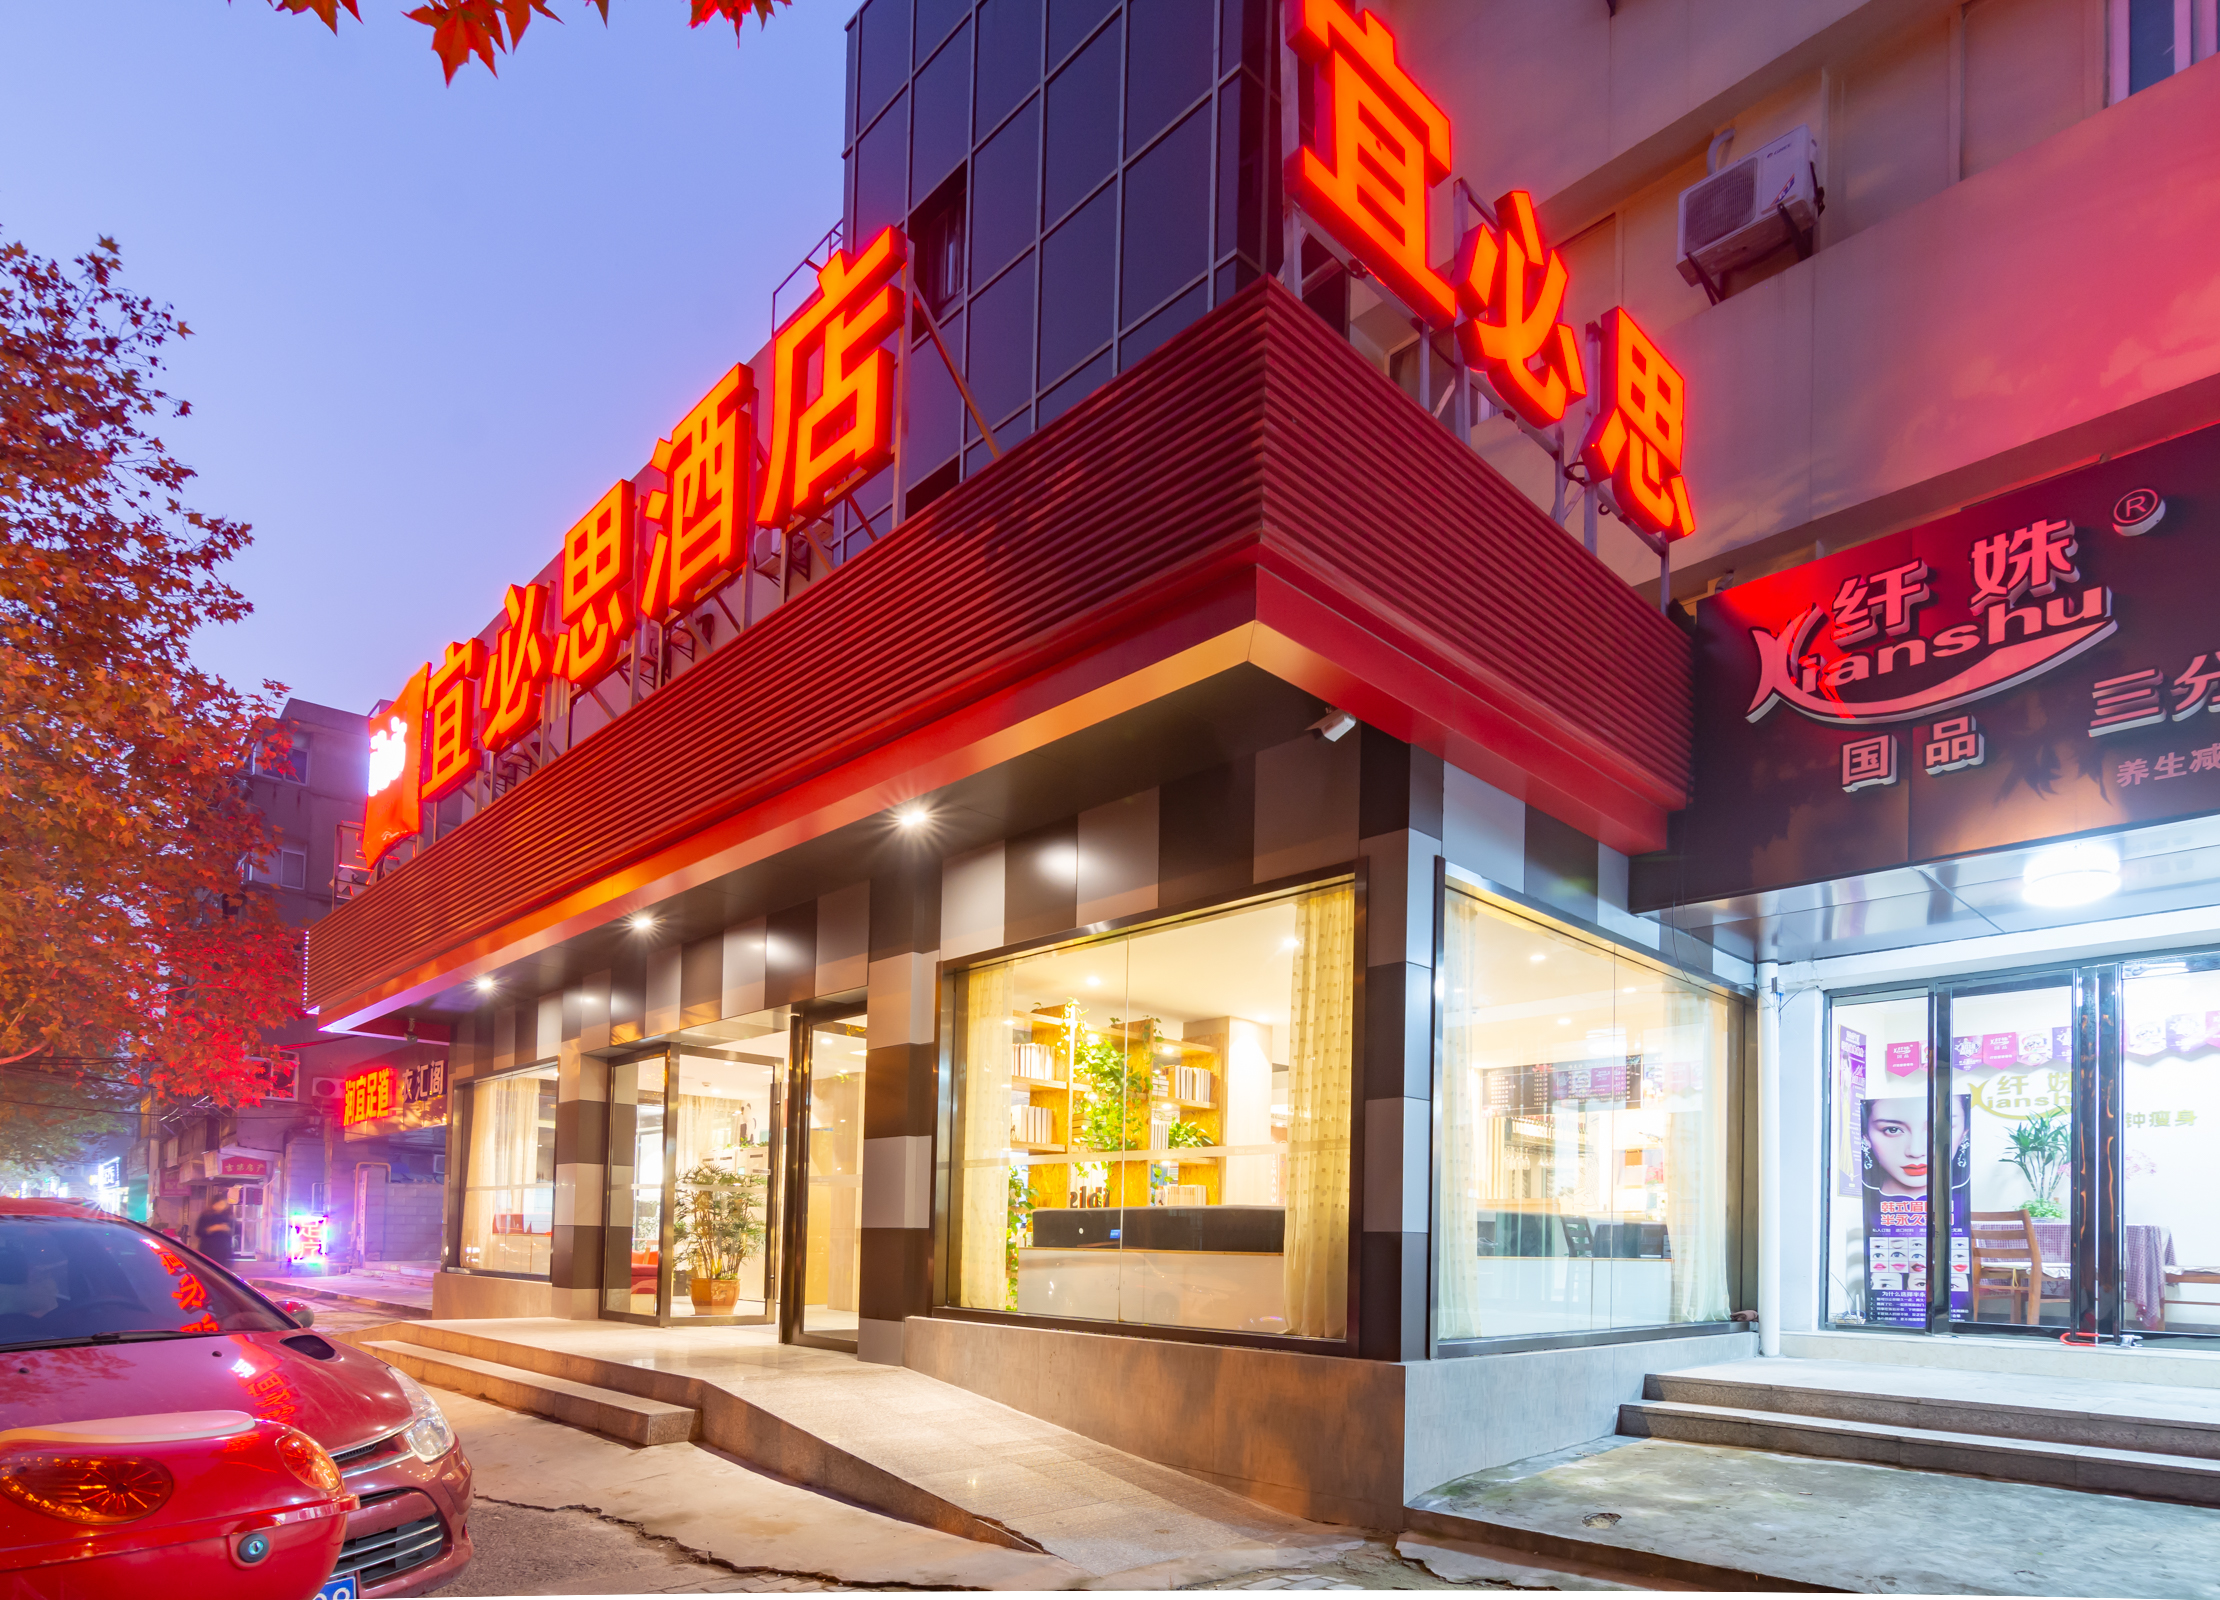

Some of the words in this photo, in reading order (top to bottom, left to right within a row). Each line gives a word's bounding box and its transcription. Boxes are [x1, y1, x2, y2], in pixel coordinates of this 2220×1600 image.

[1287, 0, 1695, 542] 宜必思
[420, 225, 906, 801] 宜必思酒店
[1832, 519, 2076, 635] 纤姝
[1841, 716, 1979, 787] 国品
